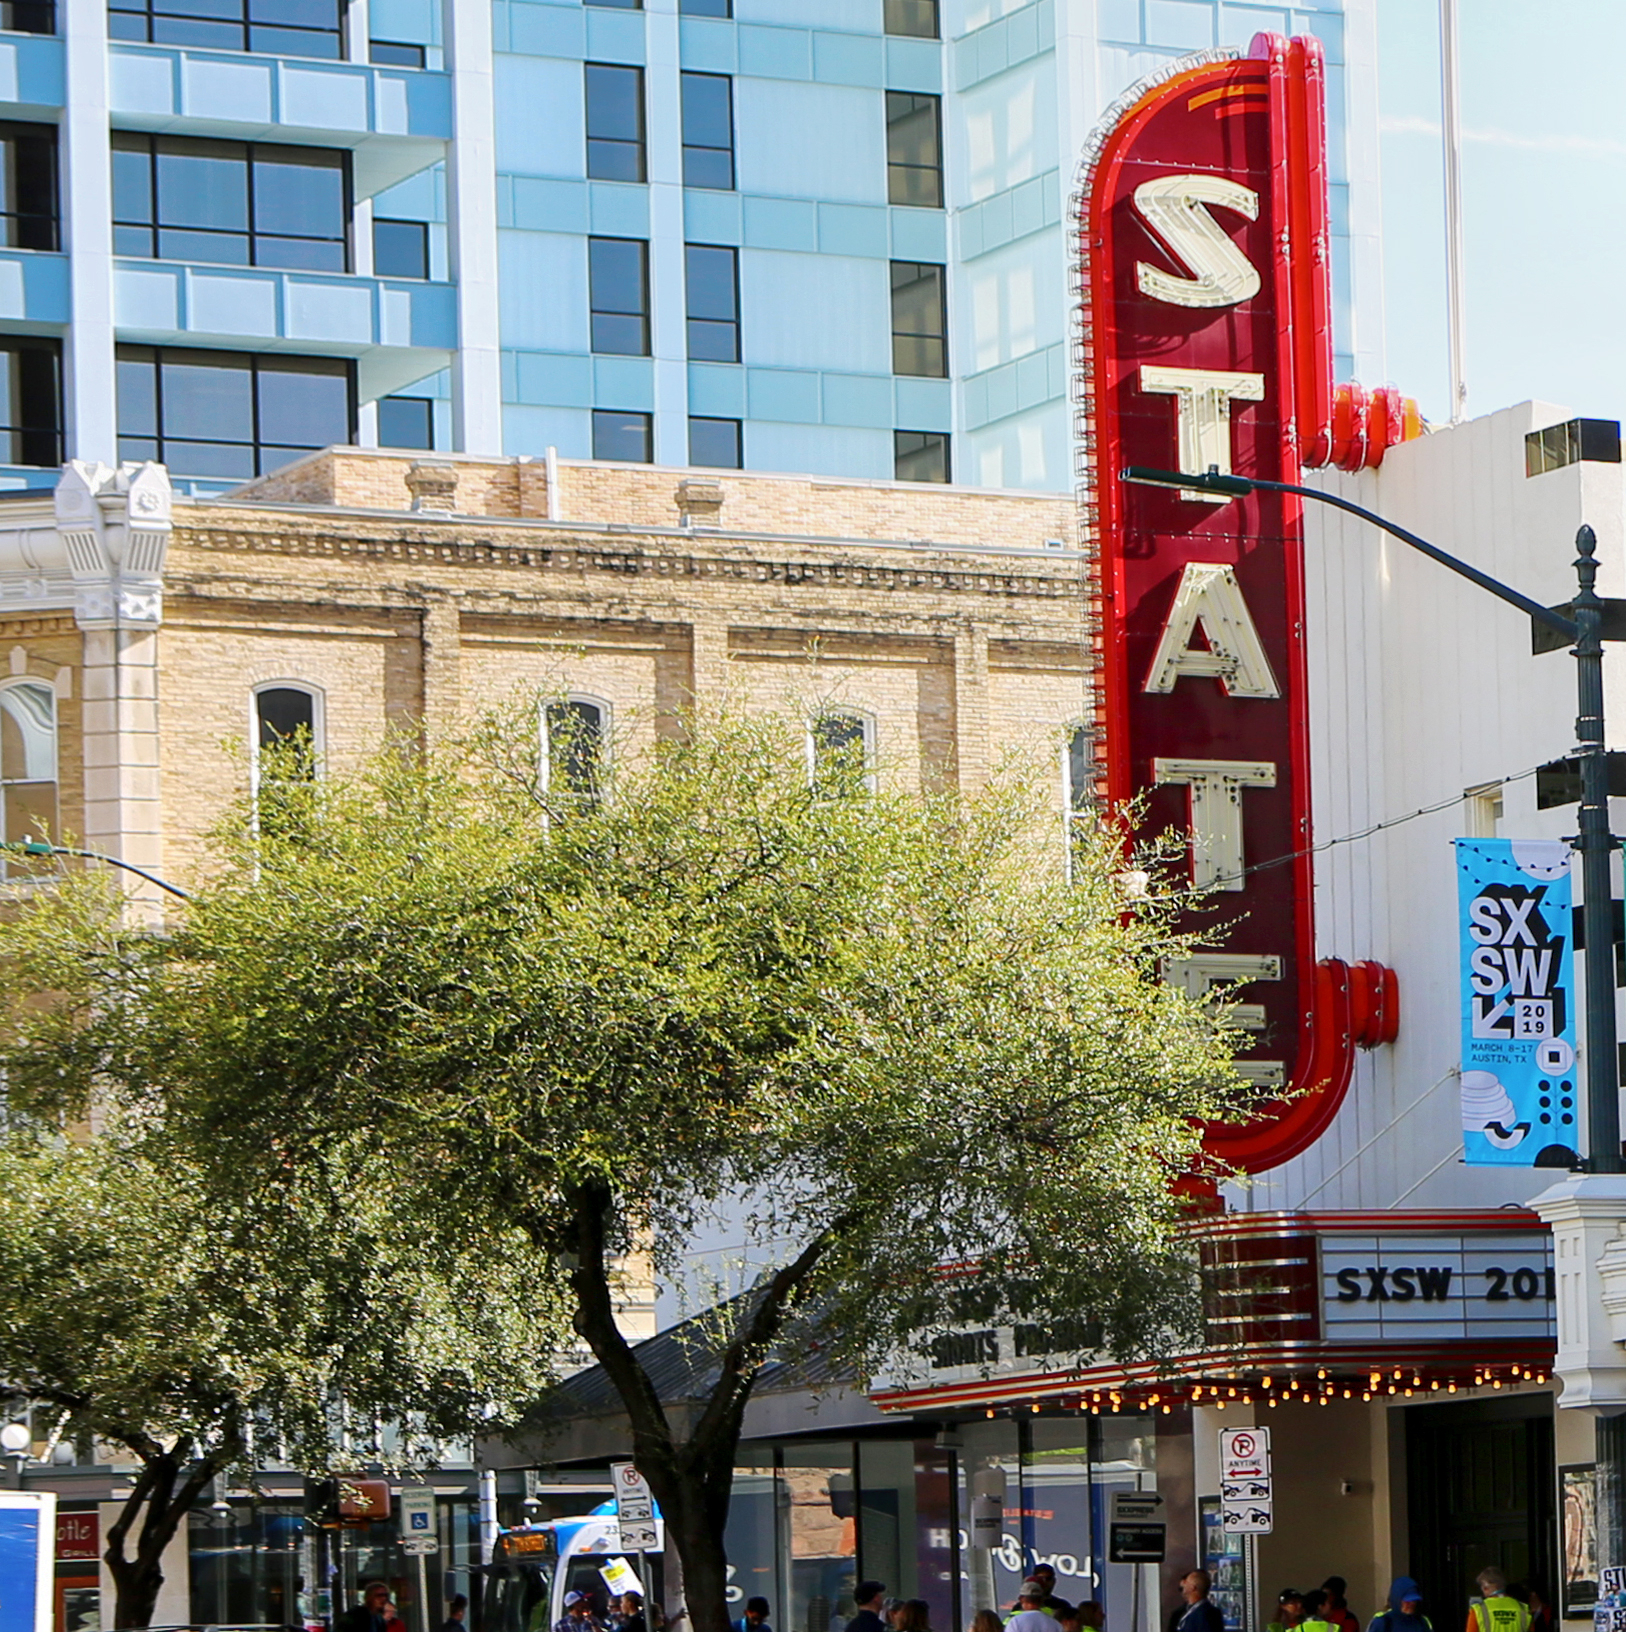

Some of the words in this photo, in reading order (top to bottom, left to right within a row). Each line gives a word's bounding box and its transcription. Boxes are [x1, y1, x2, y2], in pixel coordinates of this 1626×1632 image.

[1132, 171, 1288, 1090] STATE
[1521, 1005, 1546, 1019] 20
[1521, 1021, 1546, 1035] 19
[1470, 1043, 1505, 1053] MARCH
[1470, 1054, 1512, 1065] AUSTIN,
[1514, 1055, 1528, 1064] TX
[1336, 1266, 1453, 1303] SXSW
[1485, 1266, 1556, 1302] 201
[1228, 1458, 1262, 1468] ANYTIME
[56, 1519, 92, 1542] otle
